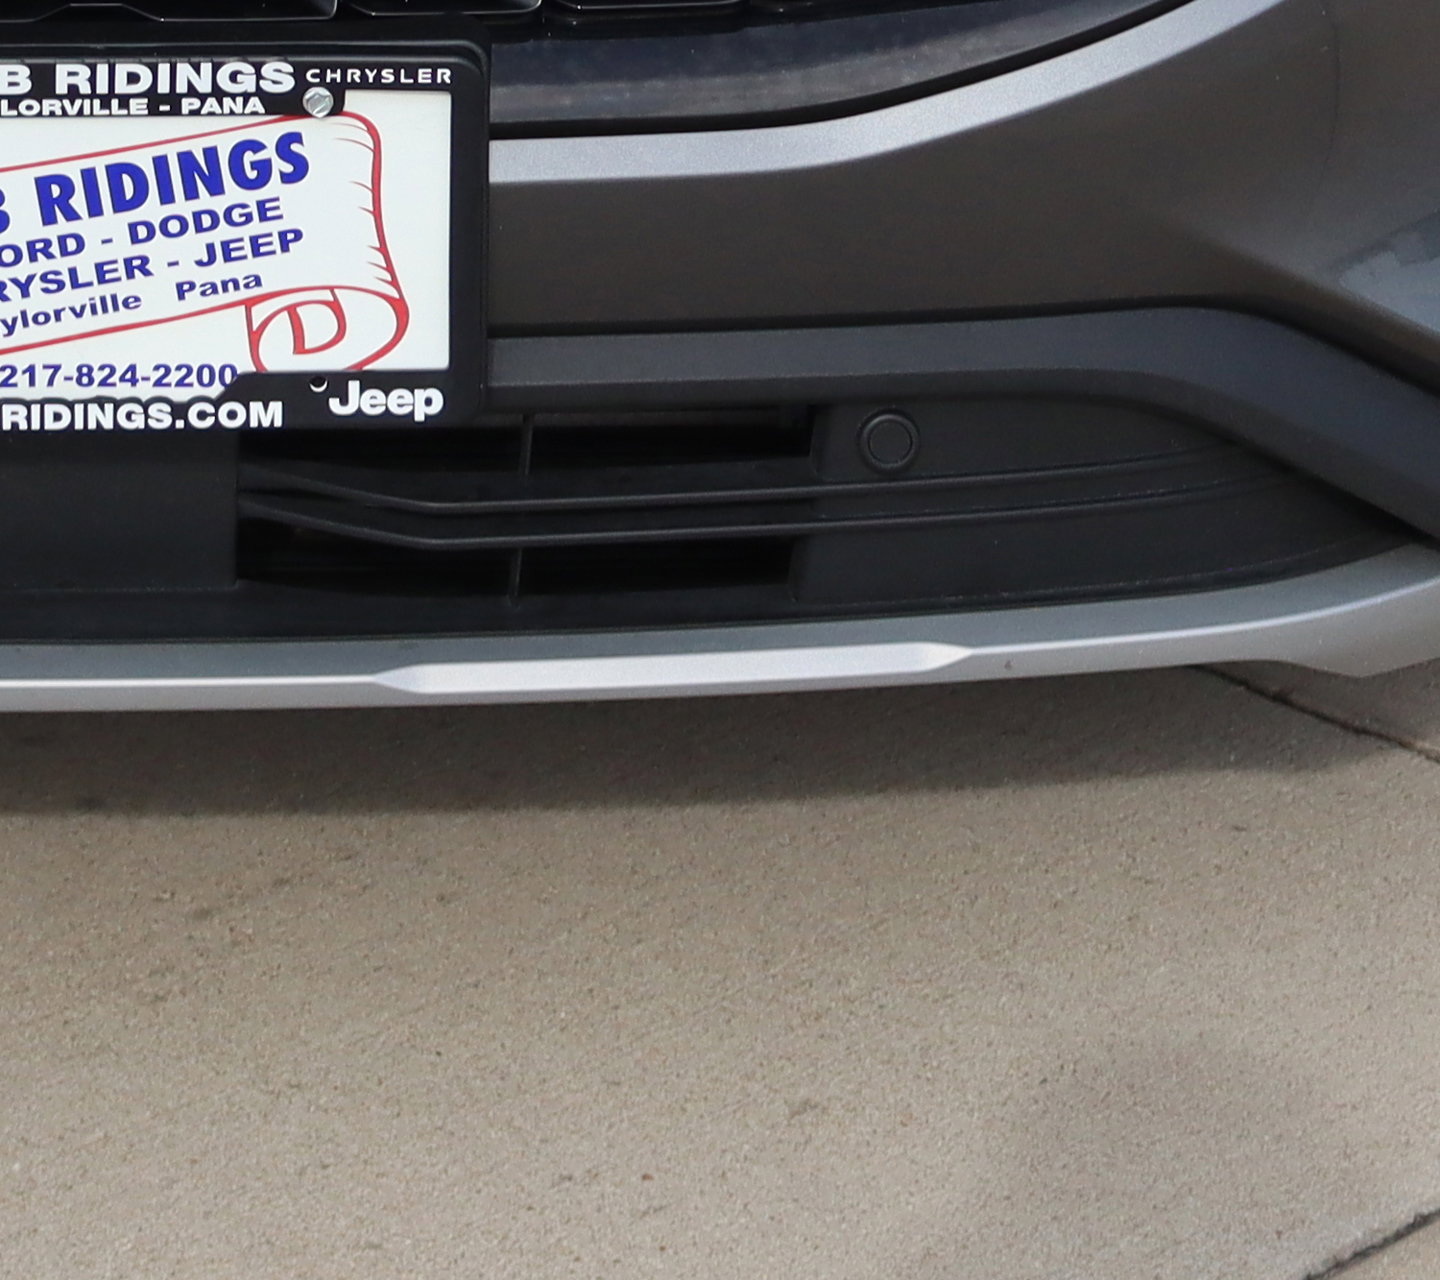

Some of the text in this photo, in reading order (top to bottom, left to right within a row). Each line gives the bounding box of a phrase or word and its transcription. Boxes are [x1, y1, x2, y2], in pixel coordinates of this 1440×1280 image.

[55, 62, 296, 95] RIDINGS
[306, 68, 452, 84] CHRYSLER
[182, 97, 266, 115] PANA
[34, 131, 309, 227] RIDINGS
[127, 197, 283, 245] DODGE
[195, 228, 304, 267] JEEP
[175, 274, 263, 301] Pana
[328, 379, 444, 422] Jeep
